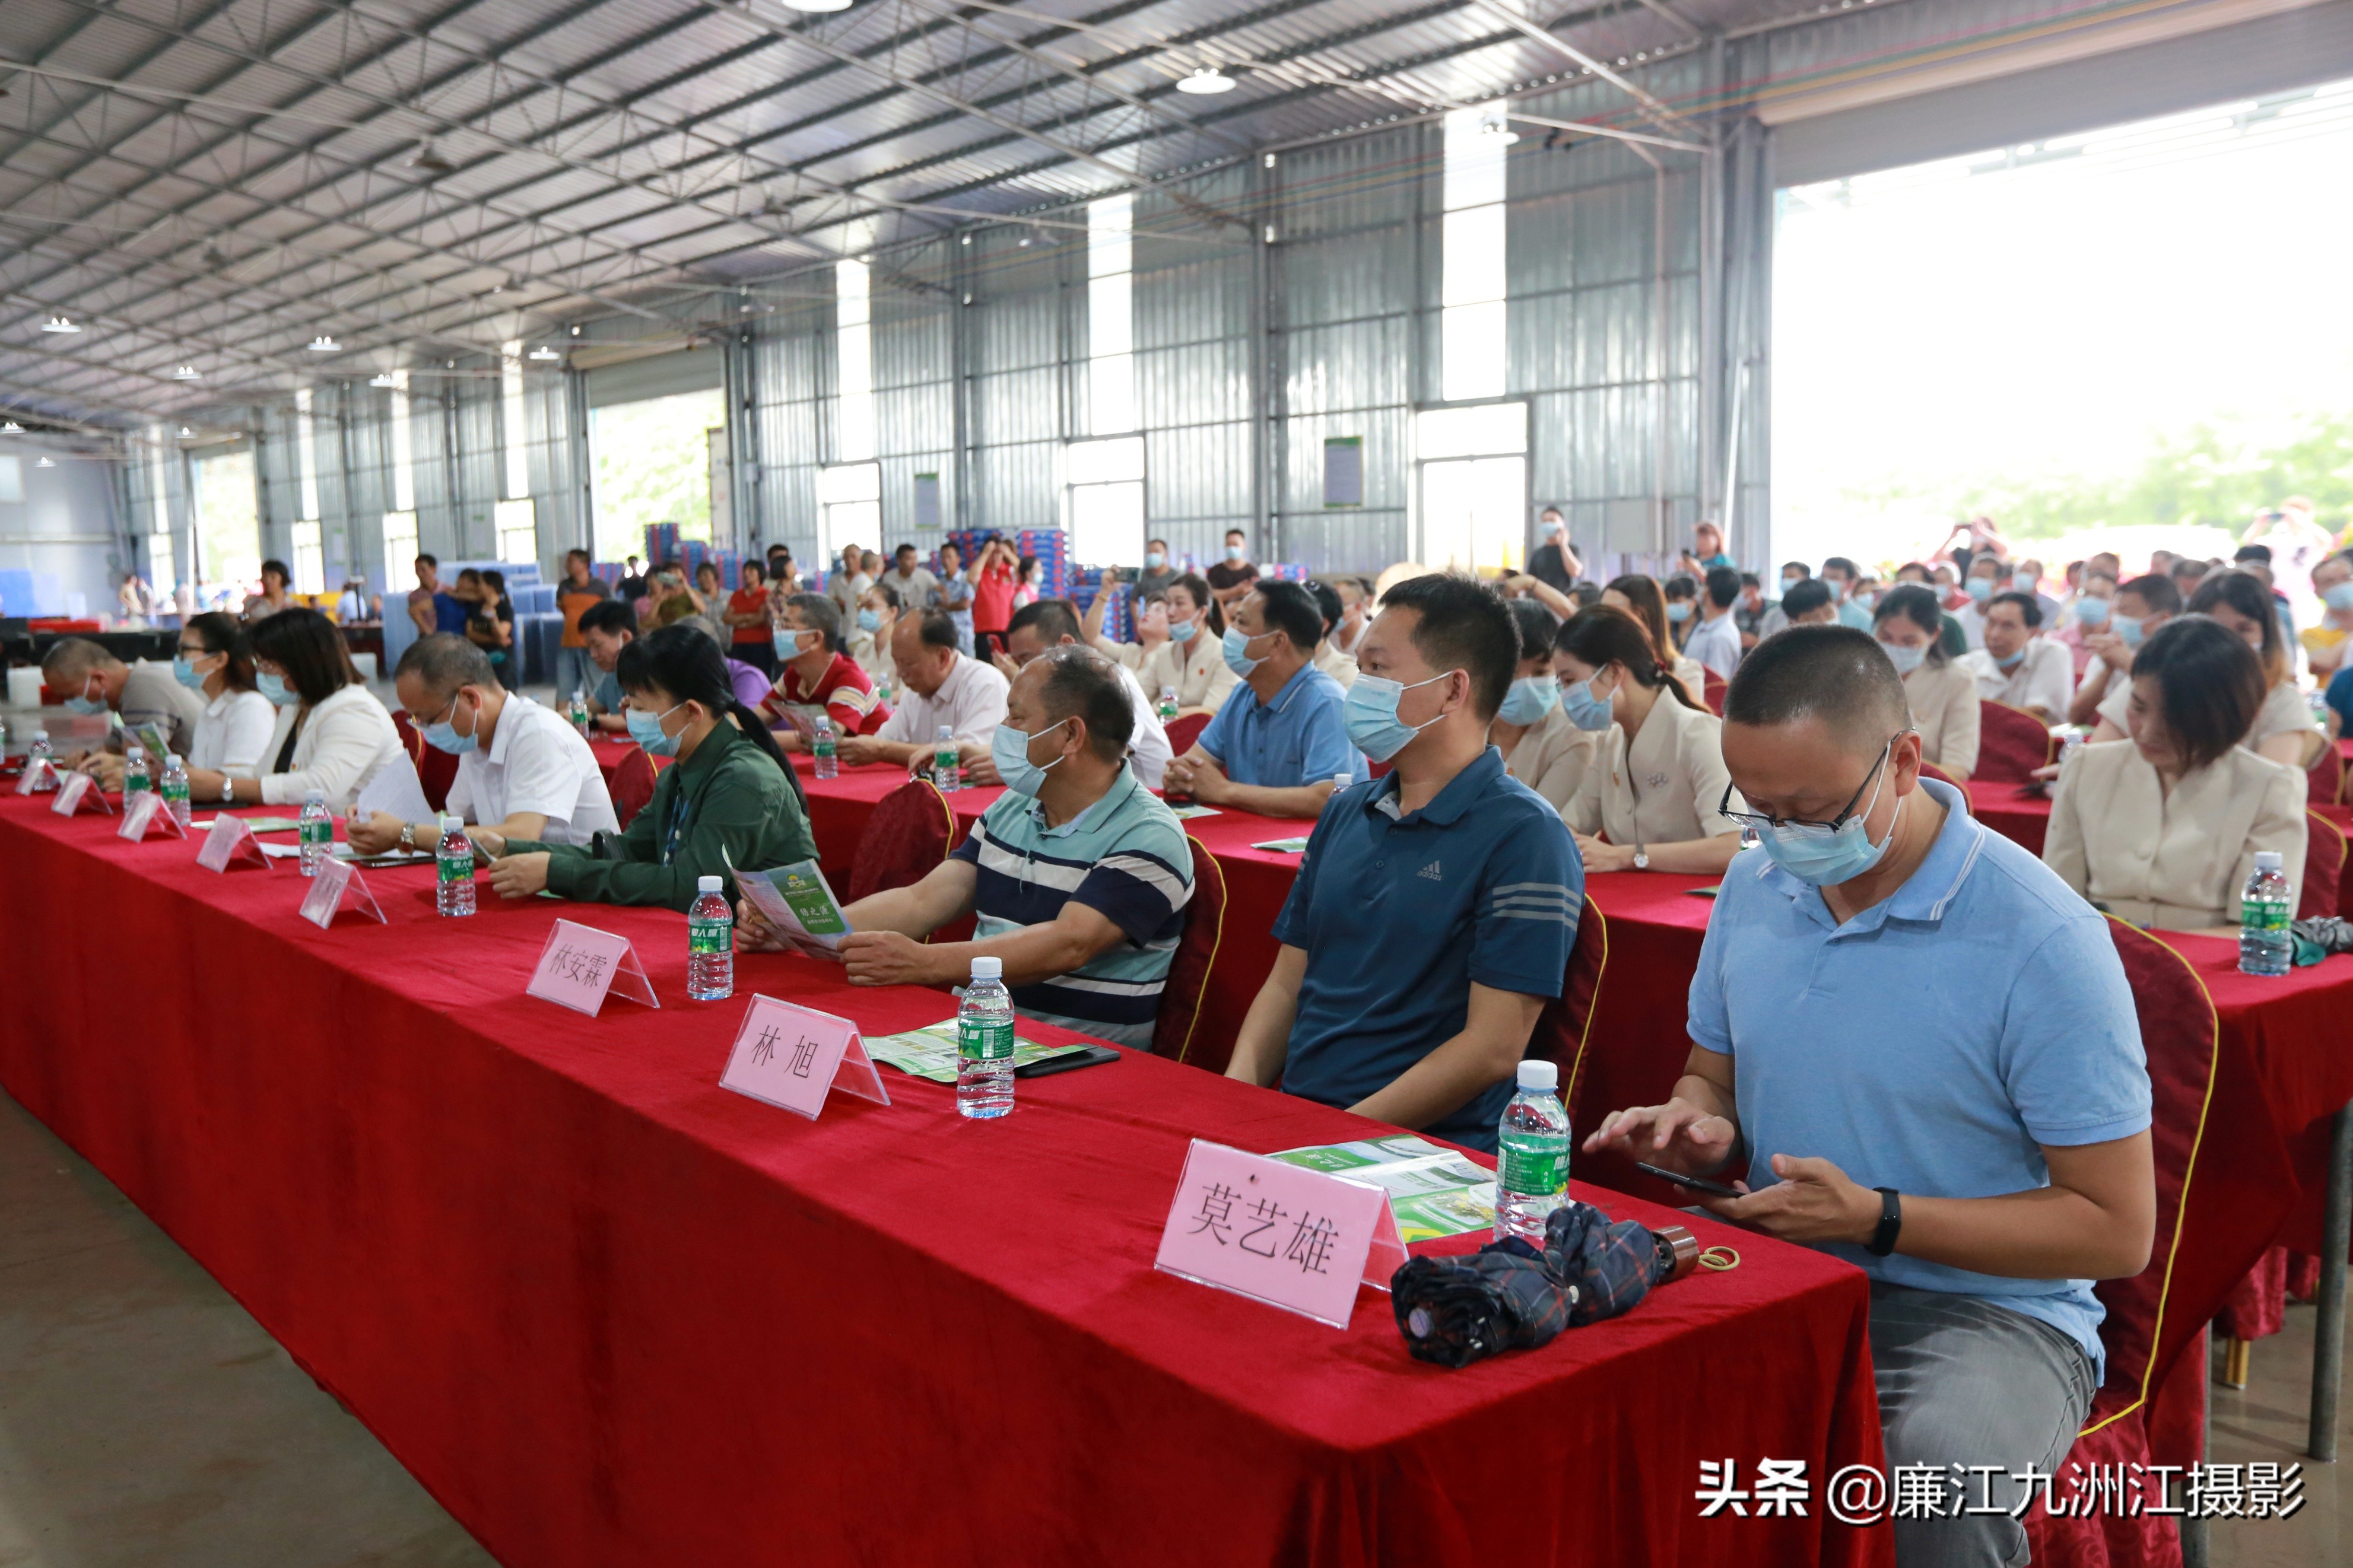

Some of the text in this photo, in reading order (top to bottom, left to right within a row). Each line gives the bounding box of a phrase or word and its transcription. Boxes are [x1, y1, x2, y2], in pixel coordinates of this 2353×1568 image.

[1417, 870, 1441, 881] adidas
[548, 943, 608, 988] 林安霖
[1186, 1181, 1340, 1276] 莫艺雄
